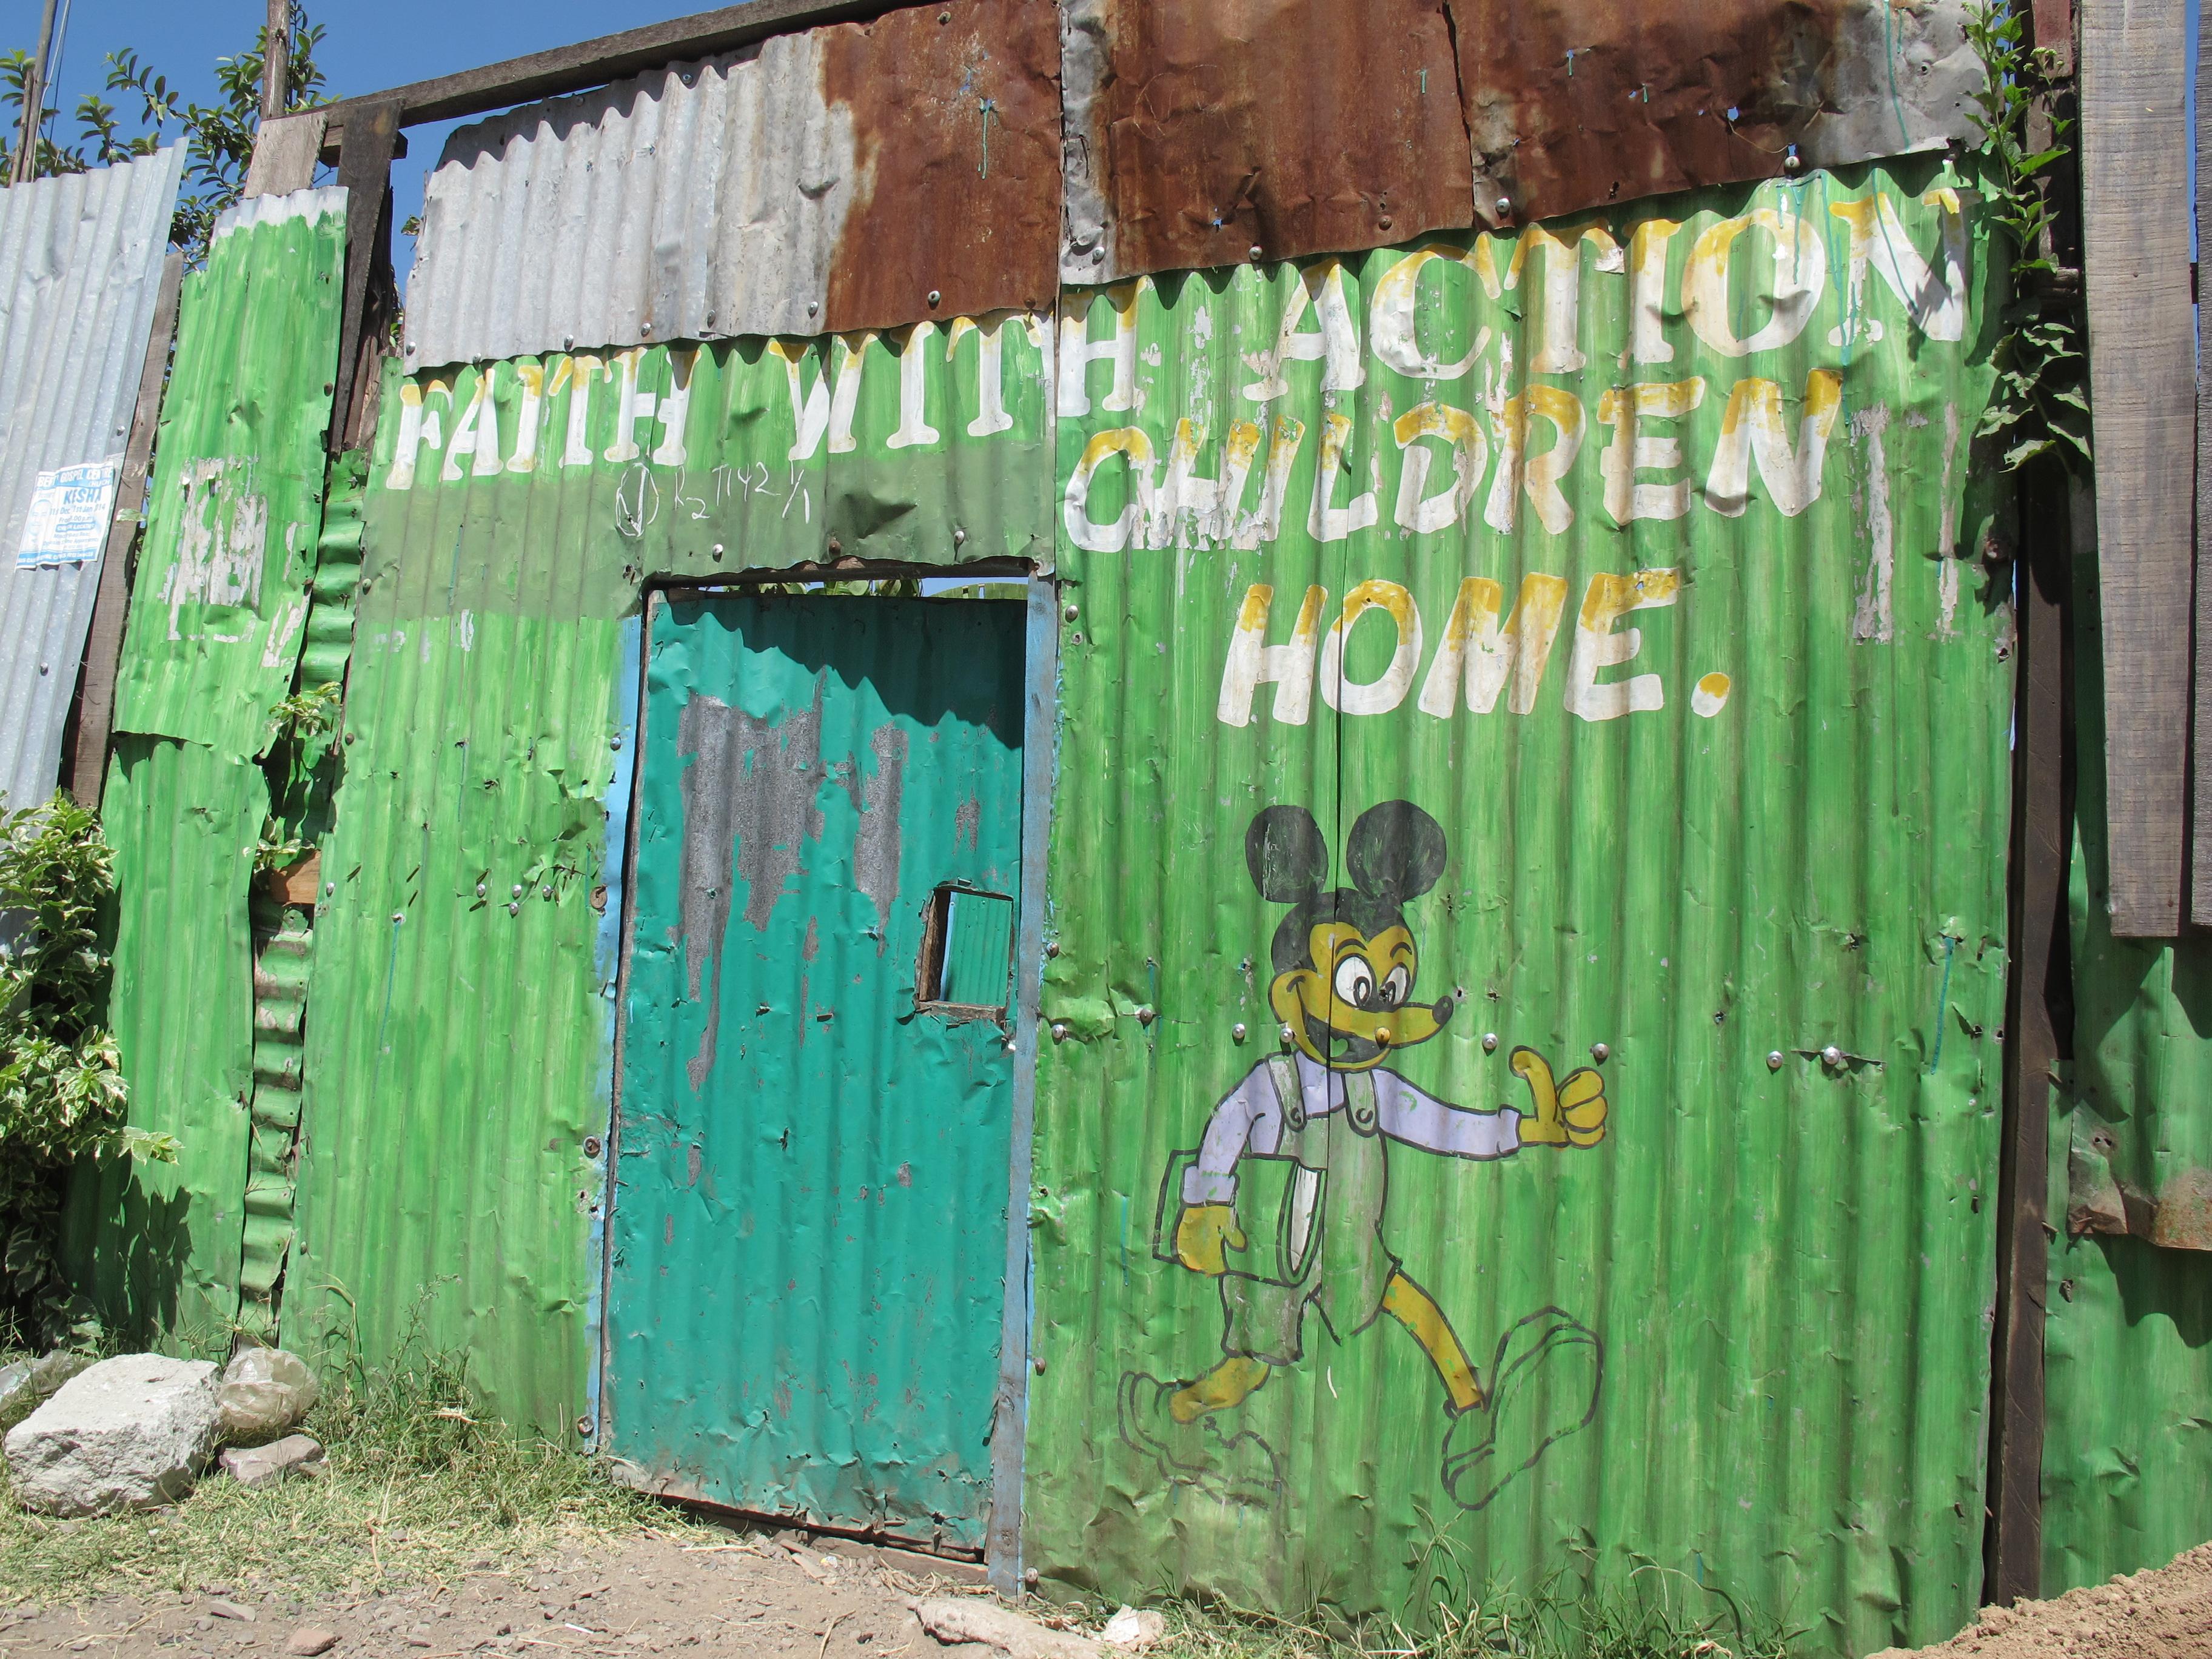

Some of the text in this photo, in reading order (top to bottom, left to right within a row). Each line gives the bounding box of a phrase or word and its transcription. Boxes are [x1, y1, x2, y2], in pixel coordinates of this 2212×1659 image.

[386, 187, 1982, 490] FAITH WITH ACTION
[1064, 369, 1843, 552] CHILDREN
[1217, 568, 1731, 728] HOME.
